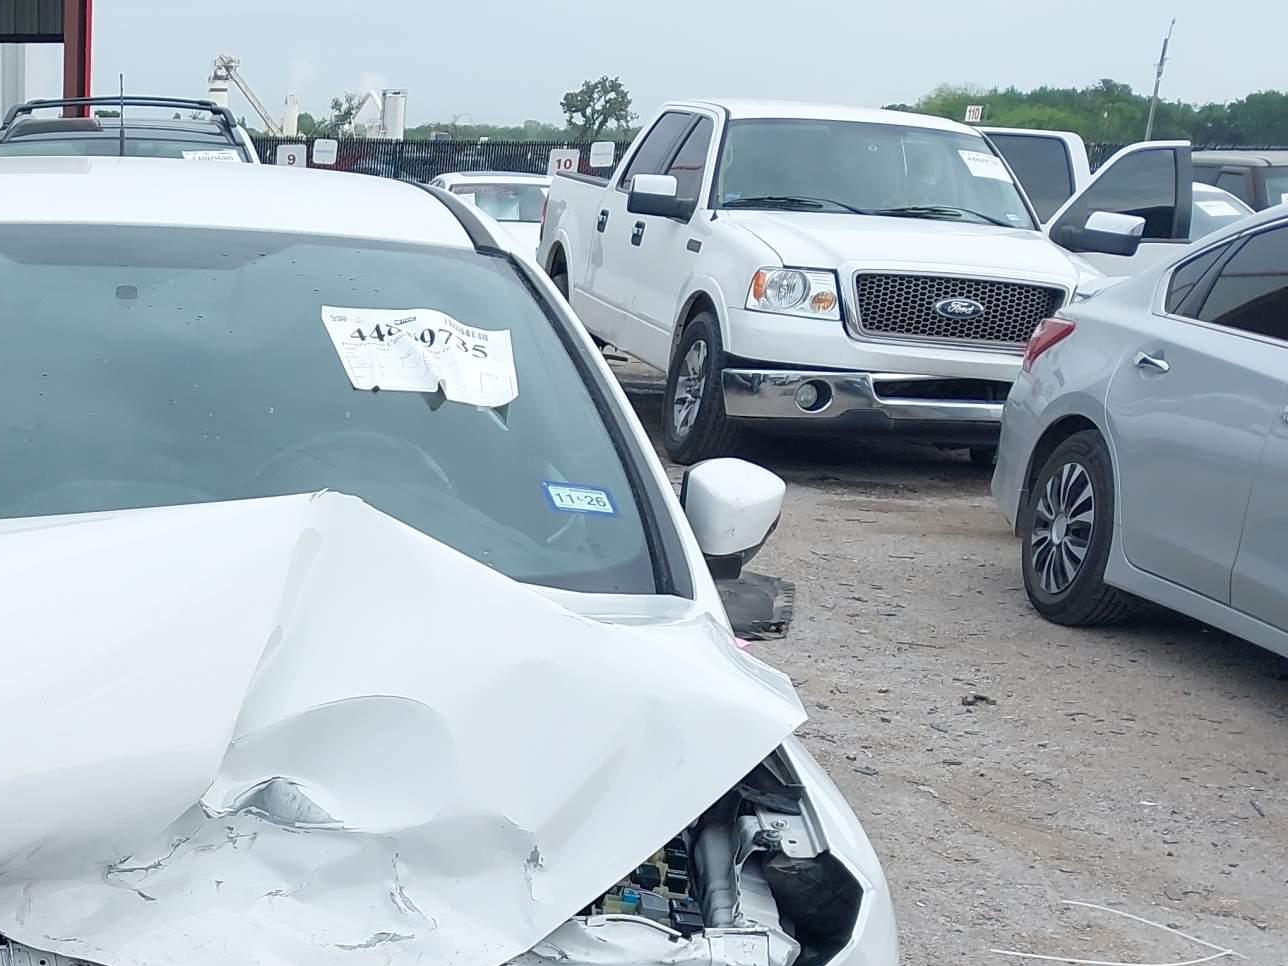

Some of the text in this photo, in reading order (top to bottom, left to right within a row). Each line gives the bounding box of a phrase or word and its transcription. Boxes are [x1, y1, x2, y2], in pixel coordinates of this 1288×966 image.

[968, 107, 980, 120] 110
[287, 153, 296, 166] 9
[556, 158, 573, 170] 10
[948, 301, 975, 314] Ford
